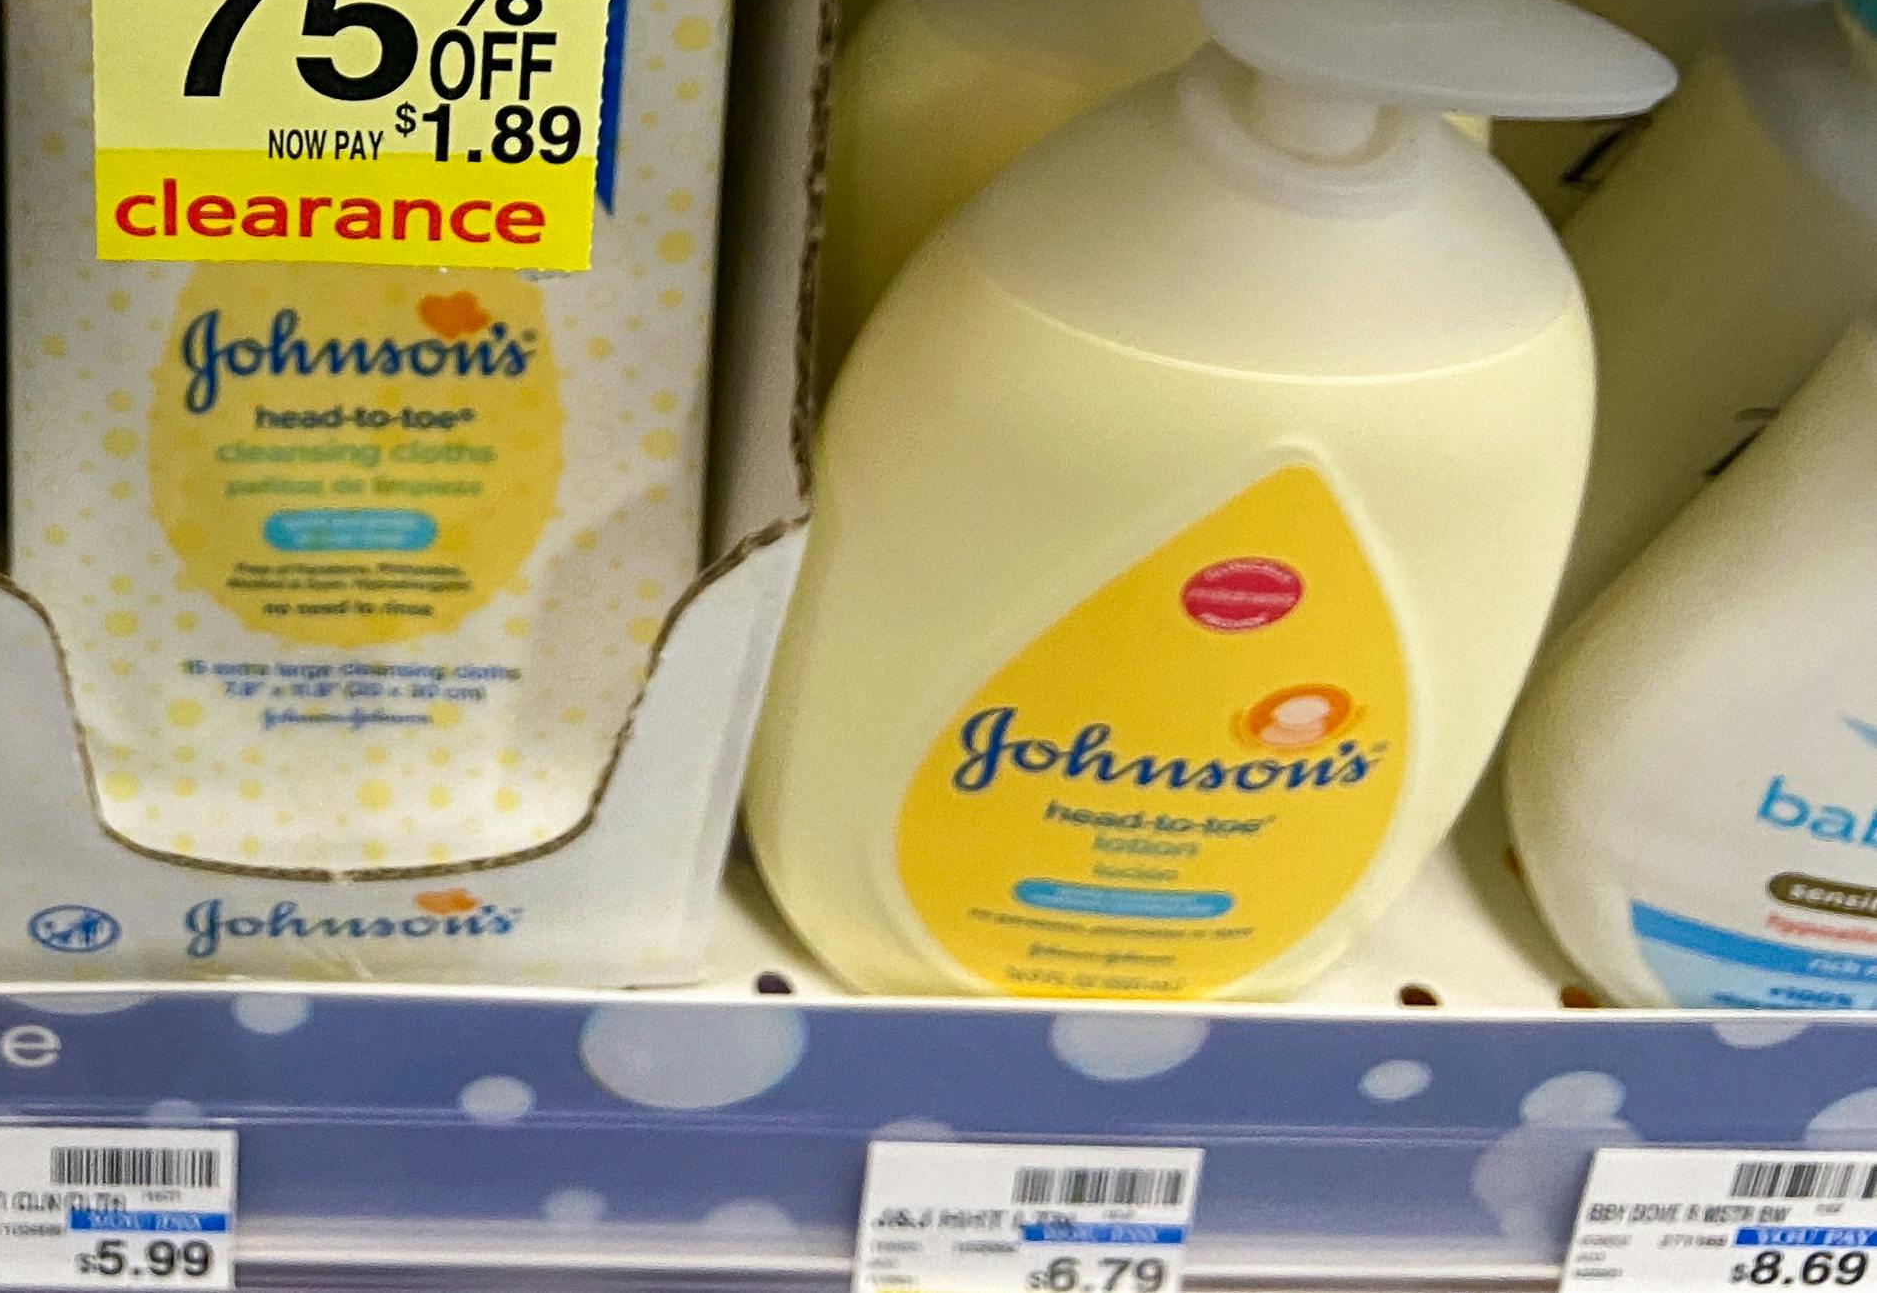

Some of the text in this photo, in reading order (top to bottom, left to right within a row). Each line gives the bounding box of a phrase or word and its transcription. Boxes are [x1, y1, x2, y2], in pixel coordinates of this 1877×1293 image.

[430, 29, 557, 101] OFF
[268, 101, 581, 165] NOW PAY $1.89
[115, 177, 546, 244] clearance
[182, 308, 535, 414] Johnson's
[952, 707, 1374, 793] Johnson's
[184, 900, 518, 958] Johnson's
[1730, 1250, 1868, 1285] $8.69
